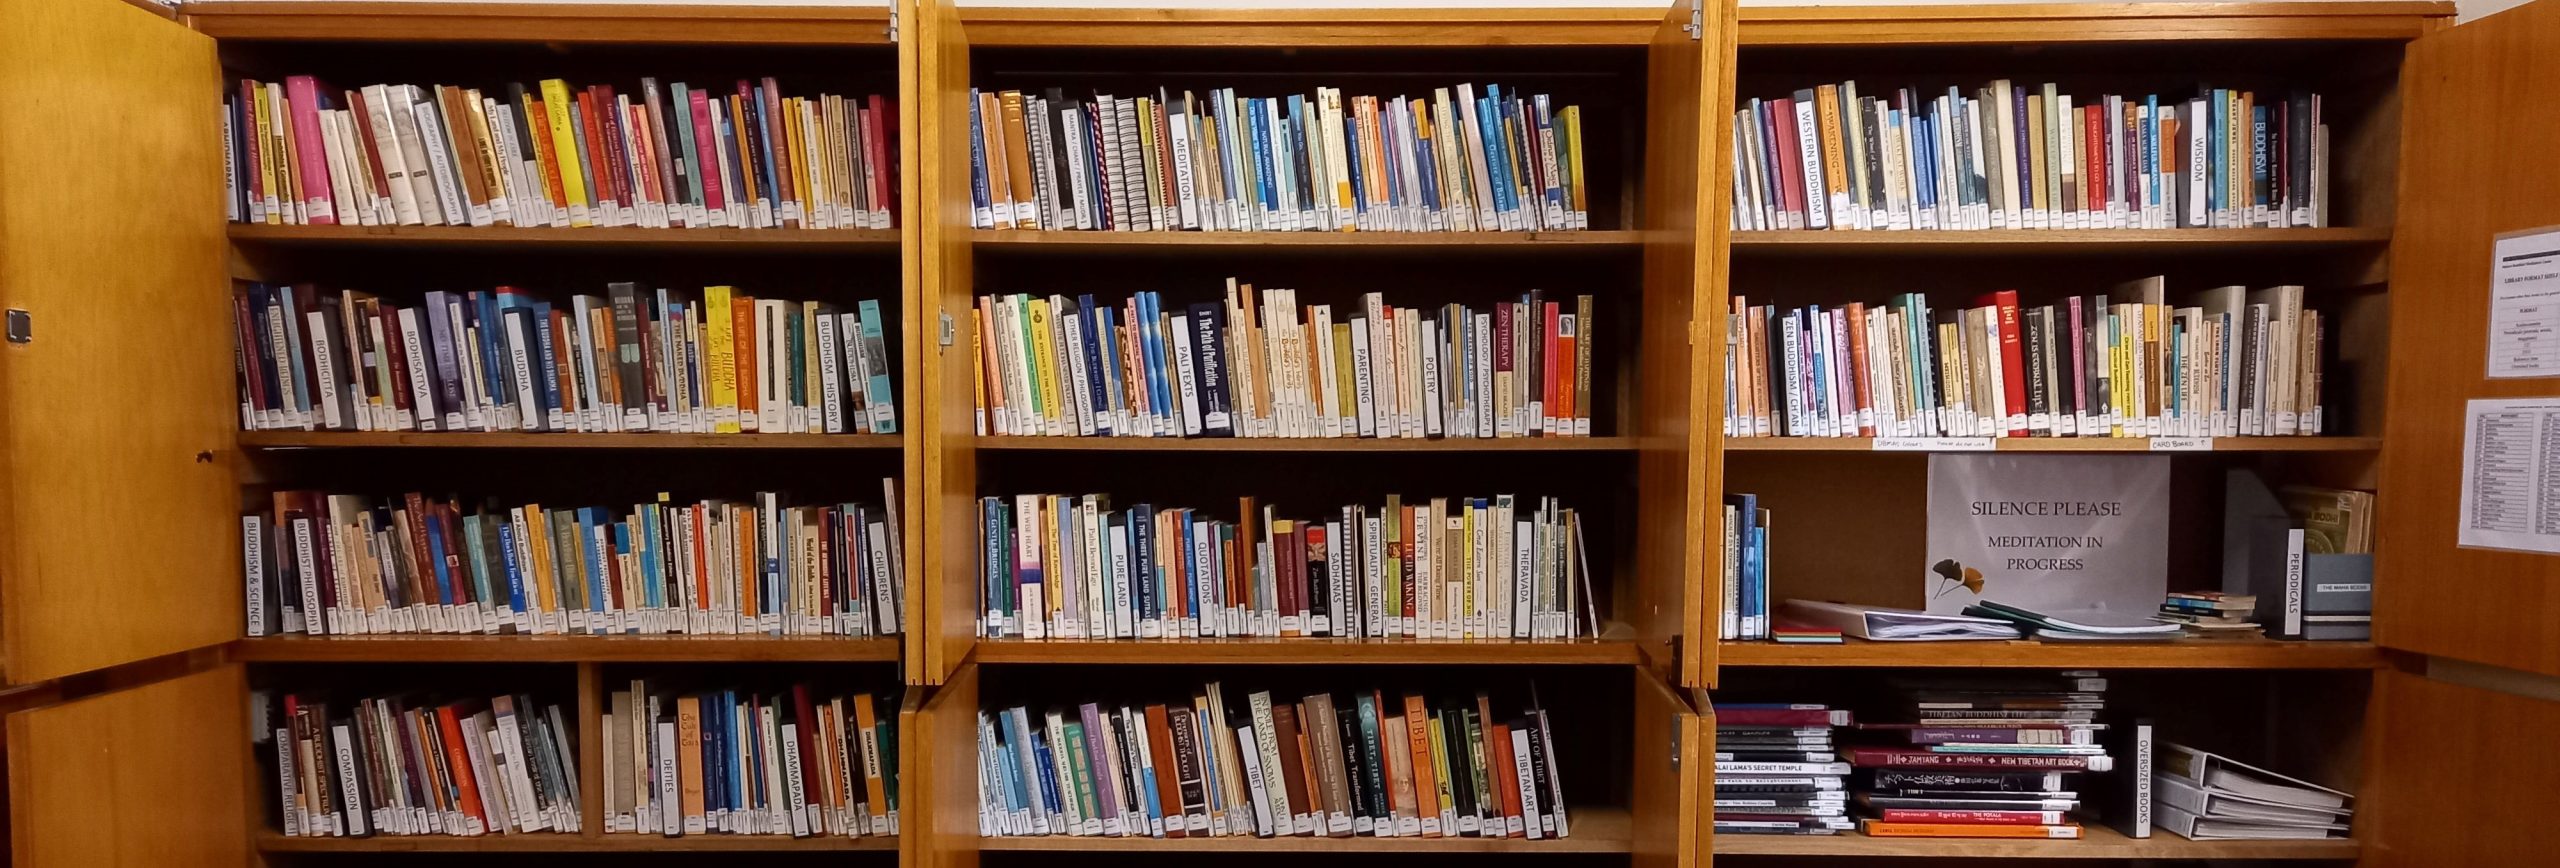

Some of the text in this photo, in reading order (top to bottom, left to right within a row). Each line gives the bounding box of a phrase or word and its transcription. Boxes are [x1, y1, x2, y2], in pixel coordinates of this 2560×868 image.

[488, 105, 494, 113] My
[490, 116, 499, 132] Land
[422, 107, 439, 147] BIOGRAPHY
[435, 155, 458, 215] AUTOBIOGRAPHY
[496, 145, 504, 154] My
[500, 156, 510, 176] People
[1068, 114, 1076, 141] MANTRA
[1076, 172, 1084, 194] PRAYER
[1176, 138, 1190, 200] MEDITATION
[1261, 130, 1273, 188] NATURAL AWAKENING
[1545, 130, 1558, 186] Ordinary Magic
[1802, 111, 1822, 214] WESTERN BUDDHISM
[2195, 138, 2204, 182] WISDOM
[2255, 122, 2266, 174] BUDDHISM
[438, 330, 447, 342] NO
[1068, 319, 1078, 342] OTHER
[1199, 318, 1212, 330] The
[1200, 331, 1214, 344] Path
[1480, 316, 1490, 362] PSYCHOLOGY
[1786, 320, 1794, 338] ZEN
[2030, 326, 2038, 342] ZEN
[271, 308, 292, 395] ENLIGHTENED BEINGS
[316, 340, 334, 398] BODHICITTA
[407, 331, 427, 398] BODHISATTVA
[441, 344, 450, 362] TIME
[540, 318, 557, 392] THE BUDDHA AND HIS DHAMMA
[674, 325, 687, 400] THE NAKED BUDDHA
[821, 322, 834, 374] BUDDHISM
[1072, 342, 1082, 374] RELIGION
[1202, 352, 1218, 387] Purification
[1500, 329, 1508, 366] THERAPY
[1787, 340, 1798, 390] BUDDHISM
[2032, 352, 2042, 388] ETERNAL
[446, 380, 456, 398] LOSE
[514, 350, 528, 392] BUDDHA
[1179, 346, 1194, 398] PALI TEXTS
[1356, 349, 1370, 404] PARENTING
[1426, 357, 1436, 393] POETRY
[826, 383, 838, 423] HISTORY
[1078, 380, 1091, 426] PHILOSOPHIES
[1482, 368, 1491, 426] PSYCHOTHERAPY
[2032, 390, 2042, 408] LIFE
[2152, 440, 2194, 448] CARD BOARD
[1972, 502, 2121, 516] SILENCE PLEASE
[248, 522, 259, 574] BUDDHISM
[990, 518, 998, 547] GENTLE
[1368, 522, 1378, 578] SPIRITUALITY
[1988, 536, 2103, 548] MEDITATION IN
[298, 523, 316, 626] BUDDHIST PHILOSOPHY
[518, 542, 527, 572] Buddhism
[874, 550, 890, 604] CHILDRENS'
[1140, 559, 1148, 574] PURE
[1198, 542, 1212, 604] QUOTATIONS
[1330, 553, 1341, 603] SADHANAS
[1434, 564, 1442, 583] Doing
[1520, 548, 1529, 603] THERAVADA
[2007, 558, 2083, 570] PROGRESS
[1116, 555, 1127, 607] PURE LAND
[1142, 576, 1150, 593] LAND
[1406, 573, 1414, 610] WAKING
[2290, 552, 2300, 614] PERIODICALS
[250, 588, 260, 626] SCIENCE
[1370, 586, 1378, 626] GENERAL
[866, 731, 876, 776] DHAMMAPADA
[1410, 706, 1428, 756] TIBET
[314, 735, 324, 774] BUDDHIST
[664, 759, 674, 792] DEITIES
[786, 741, 802, 811] DHAMMAPADA
[838, 738, 850, 800] DHAMMAPADA
[1348, 744, 1364, 810] Tibet Transformed
[1366, 729, 1380, 790] TIBET, TIBET
[1530, 728, 1545, 784] ART OF TIBET
[1908, 754, 2072, 766] JAMYANG NEW TIBETAN ART BOOK
[278, 731, 296, 824] COMPARATIVE RELIGI
[340, 748, 358, 810] COMPASSION
[1249, 765, 1262, 790] TIBET
[1518, 754, 1534, 812] TIBETAN ART
[2138, 740, 2148, 824] OVERSIZED BOOKS
